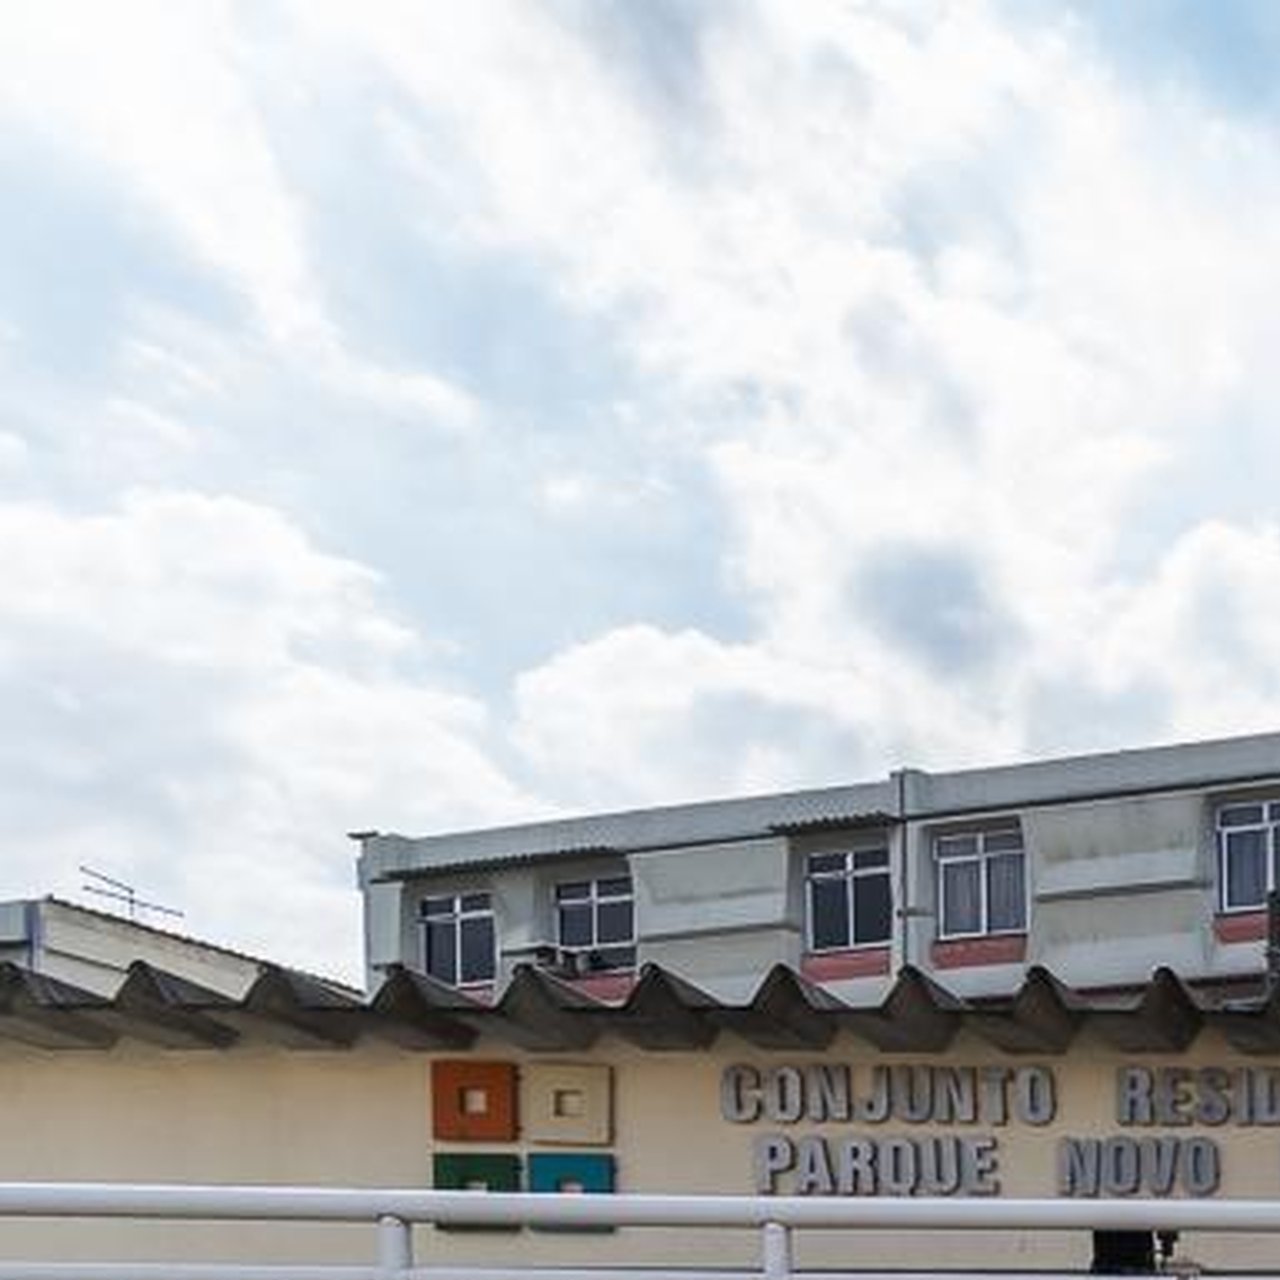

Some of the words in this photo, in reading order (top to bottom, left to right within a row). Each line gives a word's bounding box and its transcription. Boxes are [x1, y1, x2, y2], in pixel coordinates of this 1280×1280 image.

[721, 1064, 1056, 1126] CONJUNTO
[757, 1135, 1000, 1196] PARQUE
[1061, 1136, 1220, 1196] NOVO
